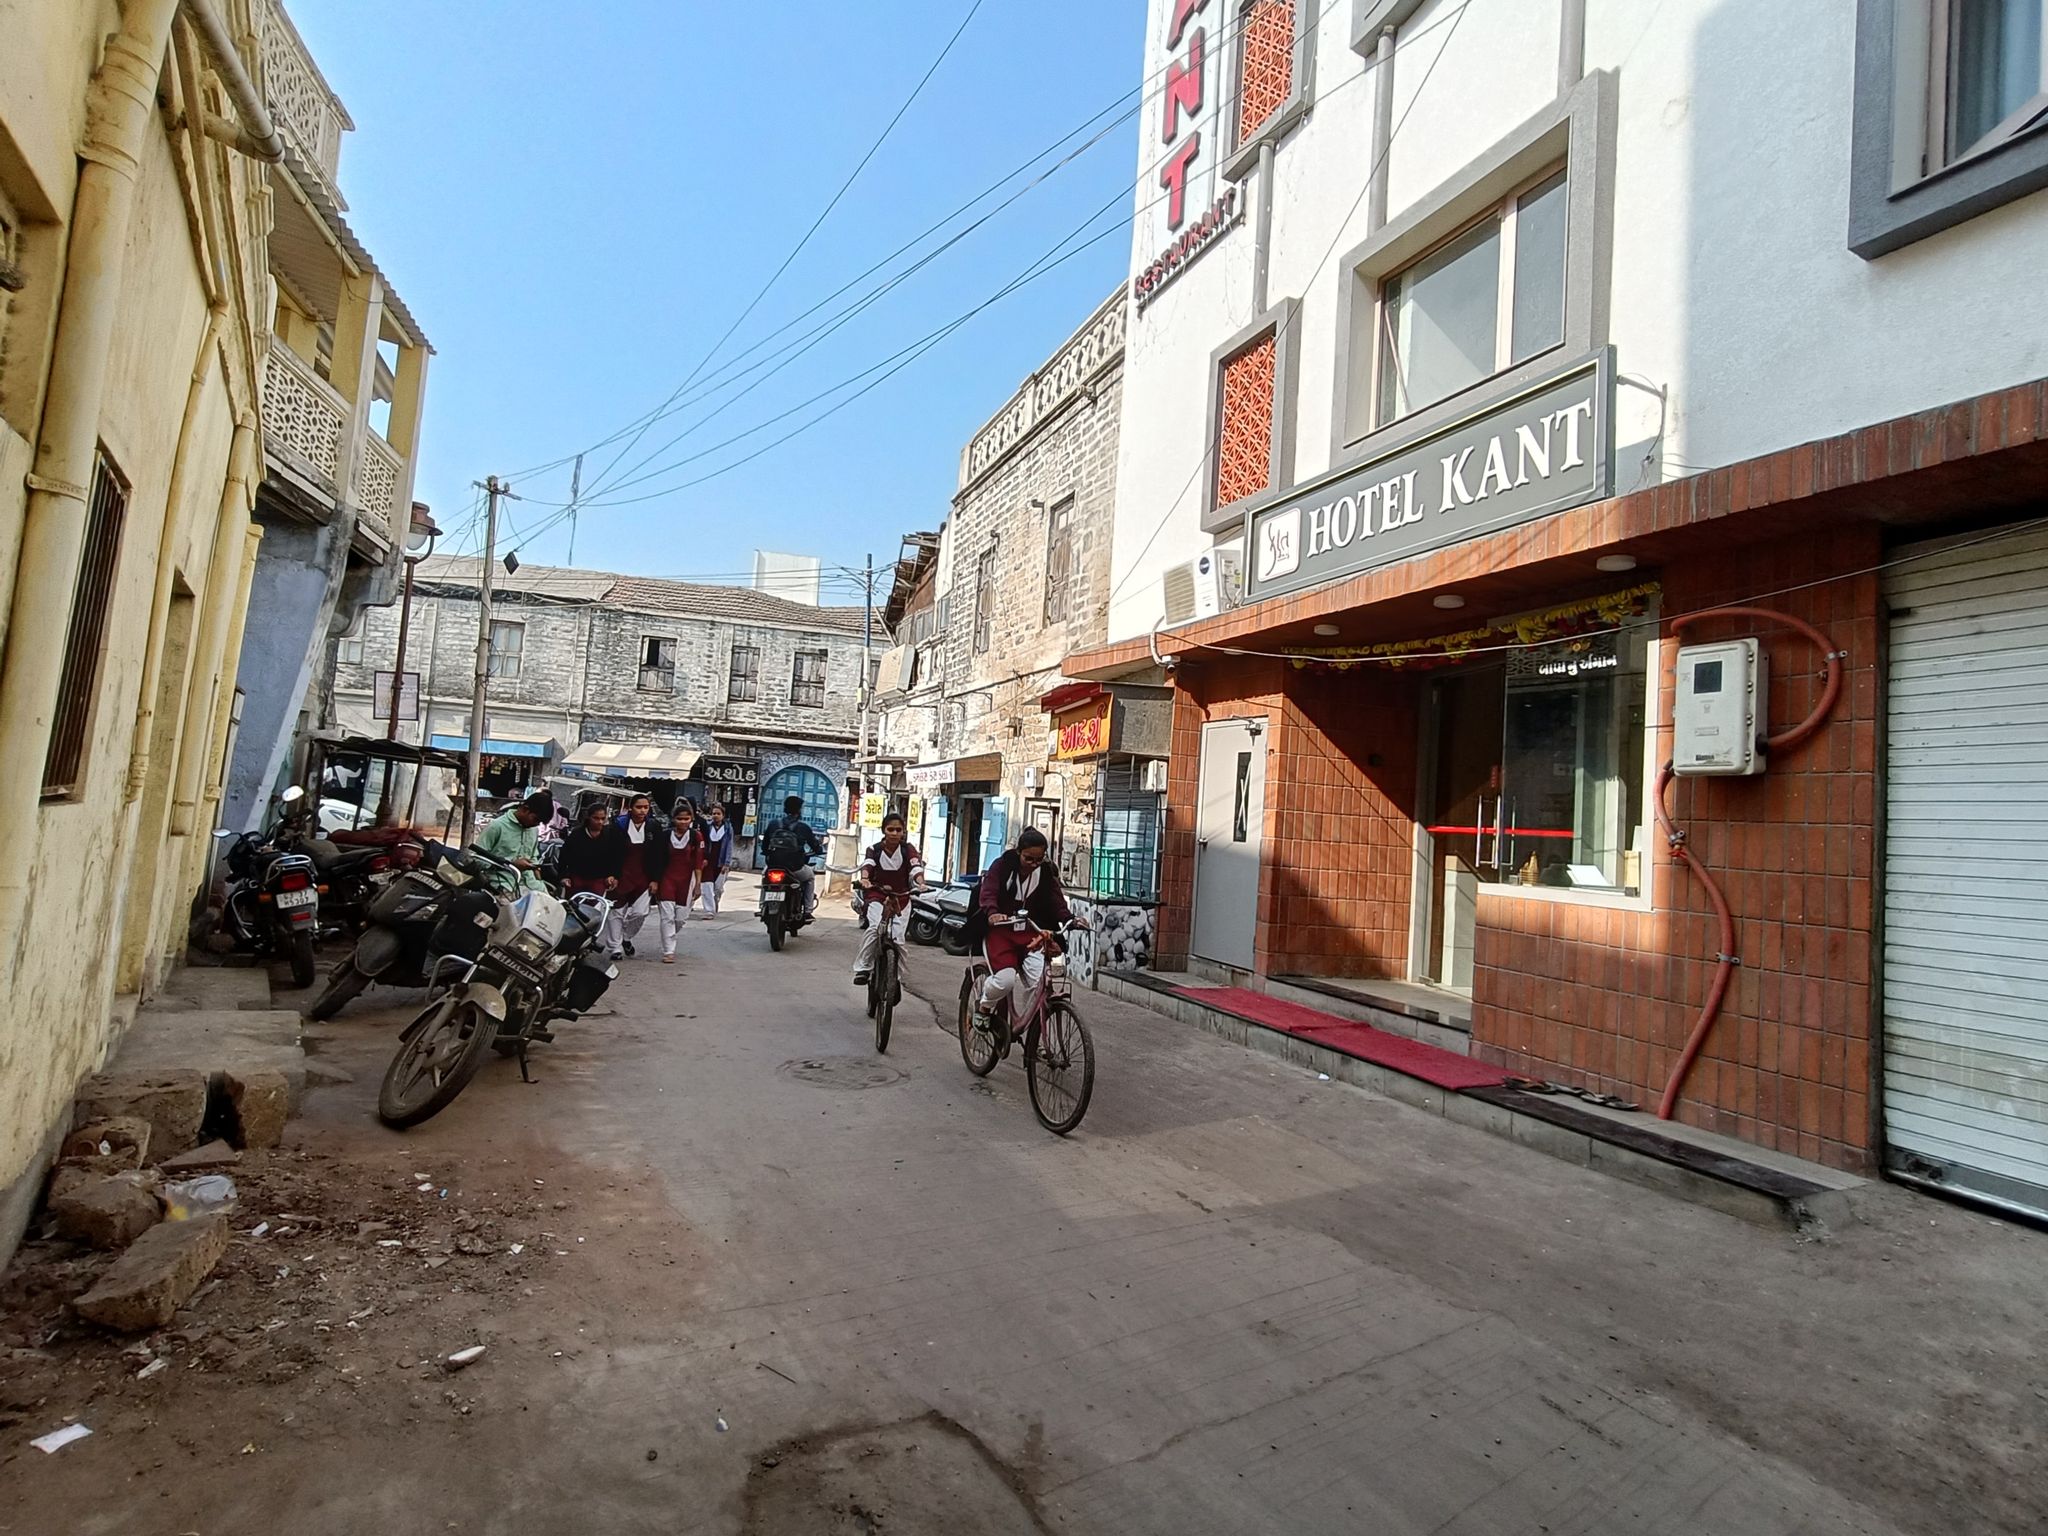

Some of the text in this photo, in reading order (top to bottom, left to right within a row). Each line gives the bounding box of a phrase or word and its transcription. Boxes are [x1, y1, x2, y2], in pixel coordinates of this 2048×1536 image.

[1134, 187, 1237, 300] RESTAURANT
[1306, 468, 1424, 557] HOTEL
[1438, 398, 1593, 514] KANT
[704, 763, 757, 782] અશોક
